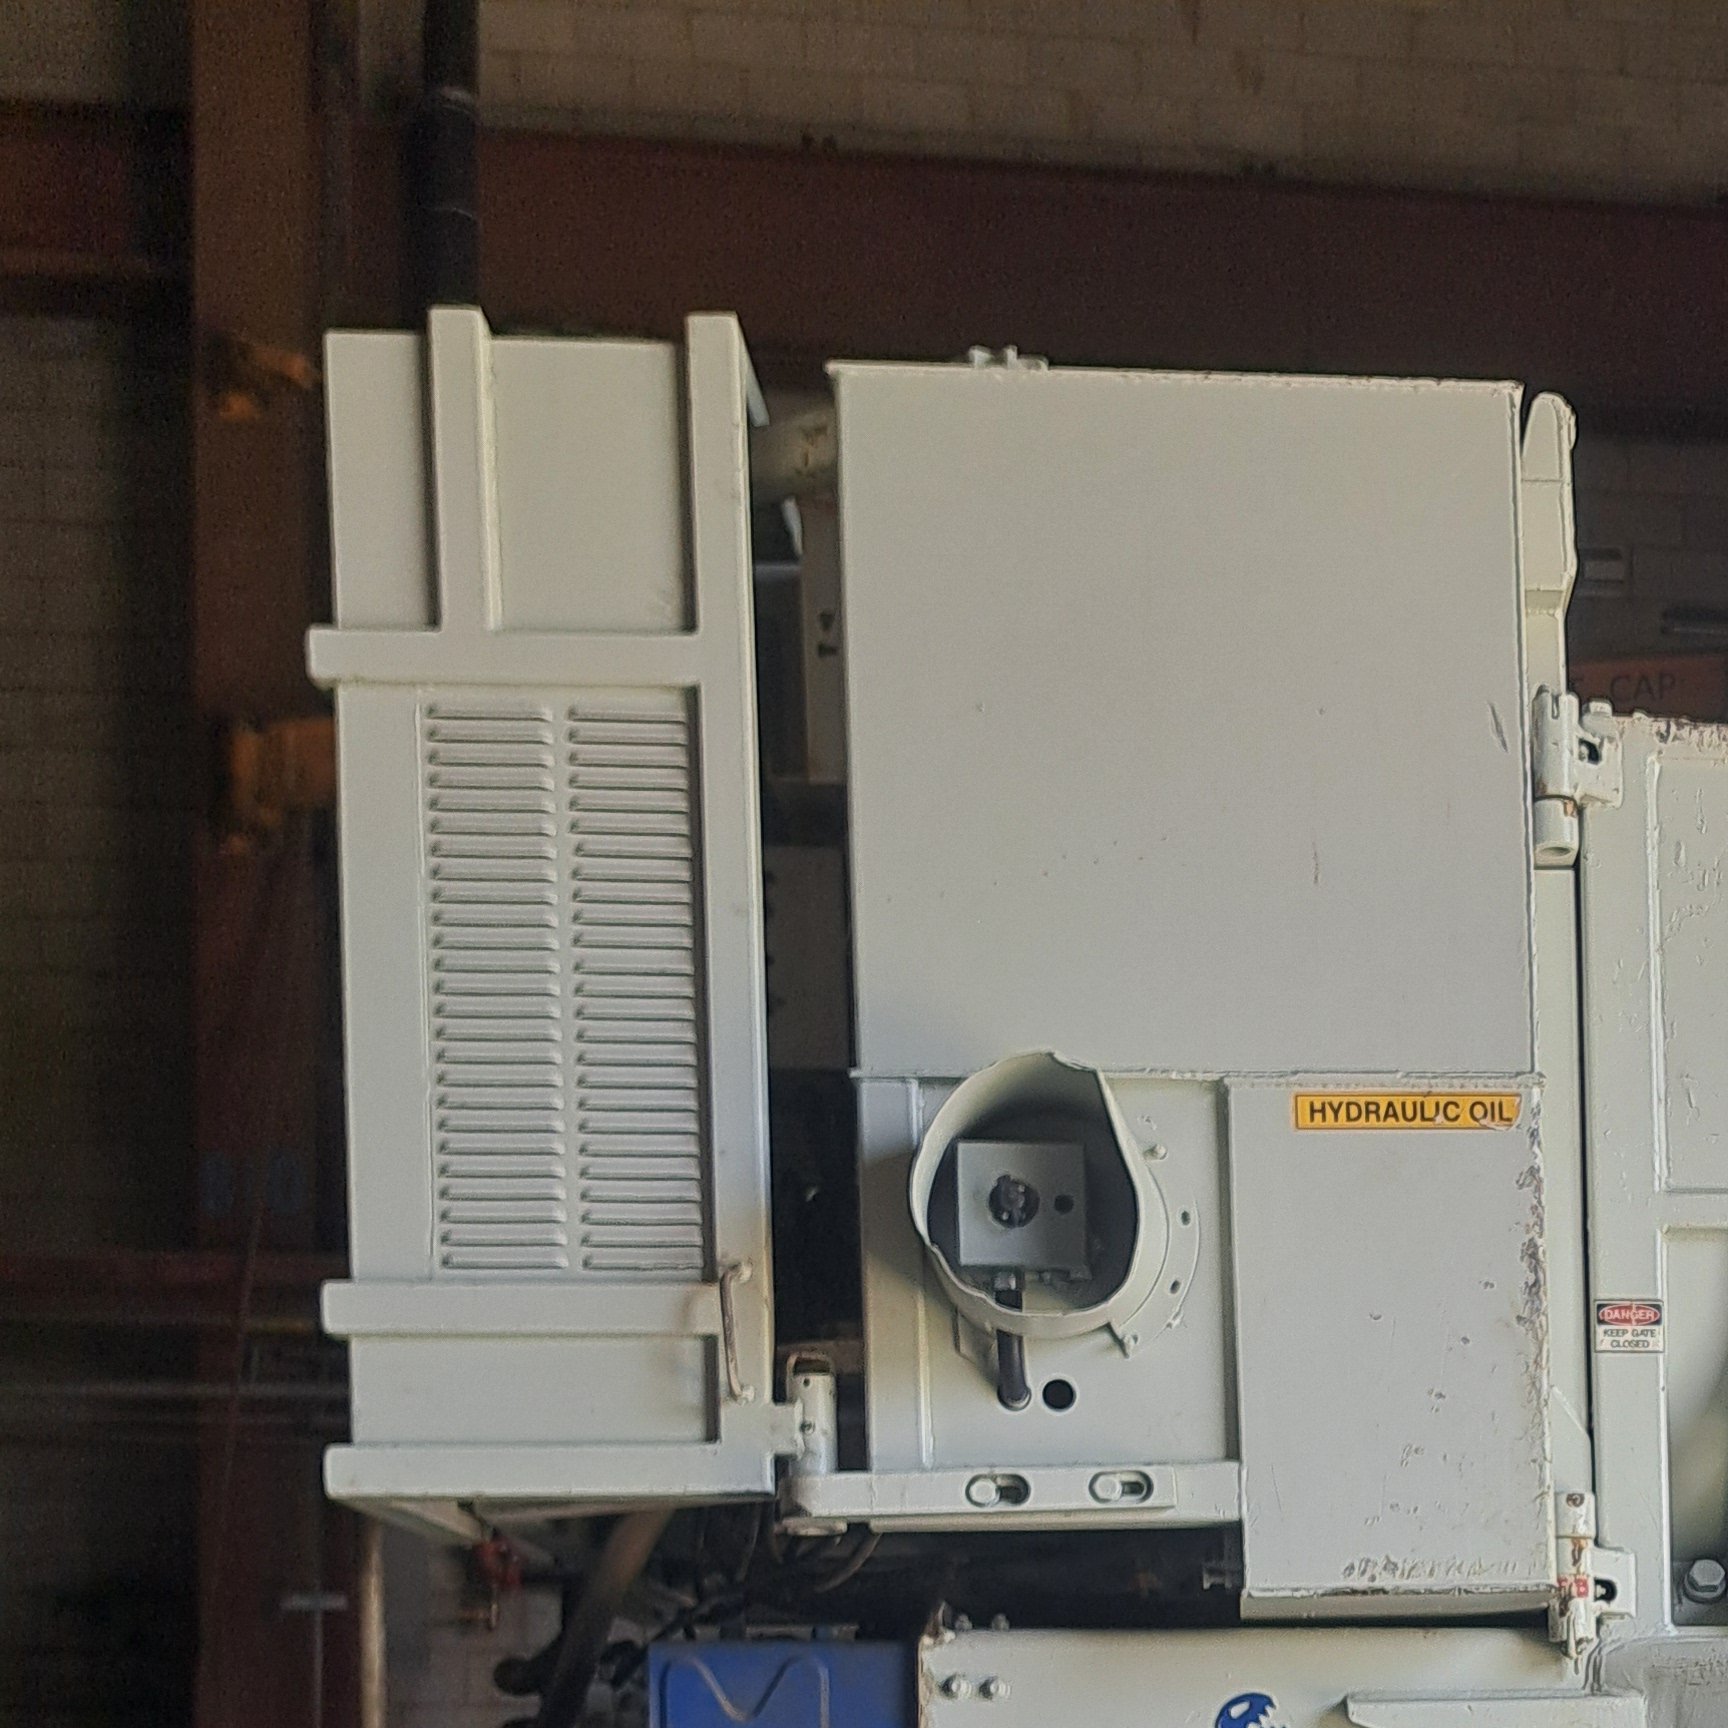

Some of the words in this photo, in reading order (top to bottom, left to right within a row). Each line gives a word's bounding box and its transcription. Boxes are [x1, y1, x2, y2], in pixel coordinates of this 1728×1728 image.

[1309, 1100, 1461, 1123] HYDRAULIC
[1469, 1100, 1514, 1123] OIL
[1604, 1309, 1655, 1320] DANGER
[1603, 1328, 1629, 1338] KEEP
[1631, 1328, 1656, 1338] GATE
[1610, 1339, 1650, 1348] CLOSED
